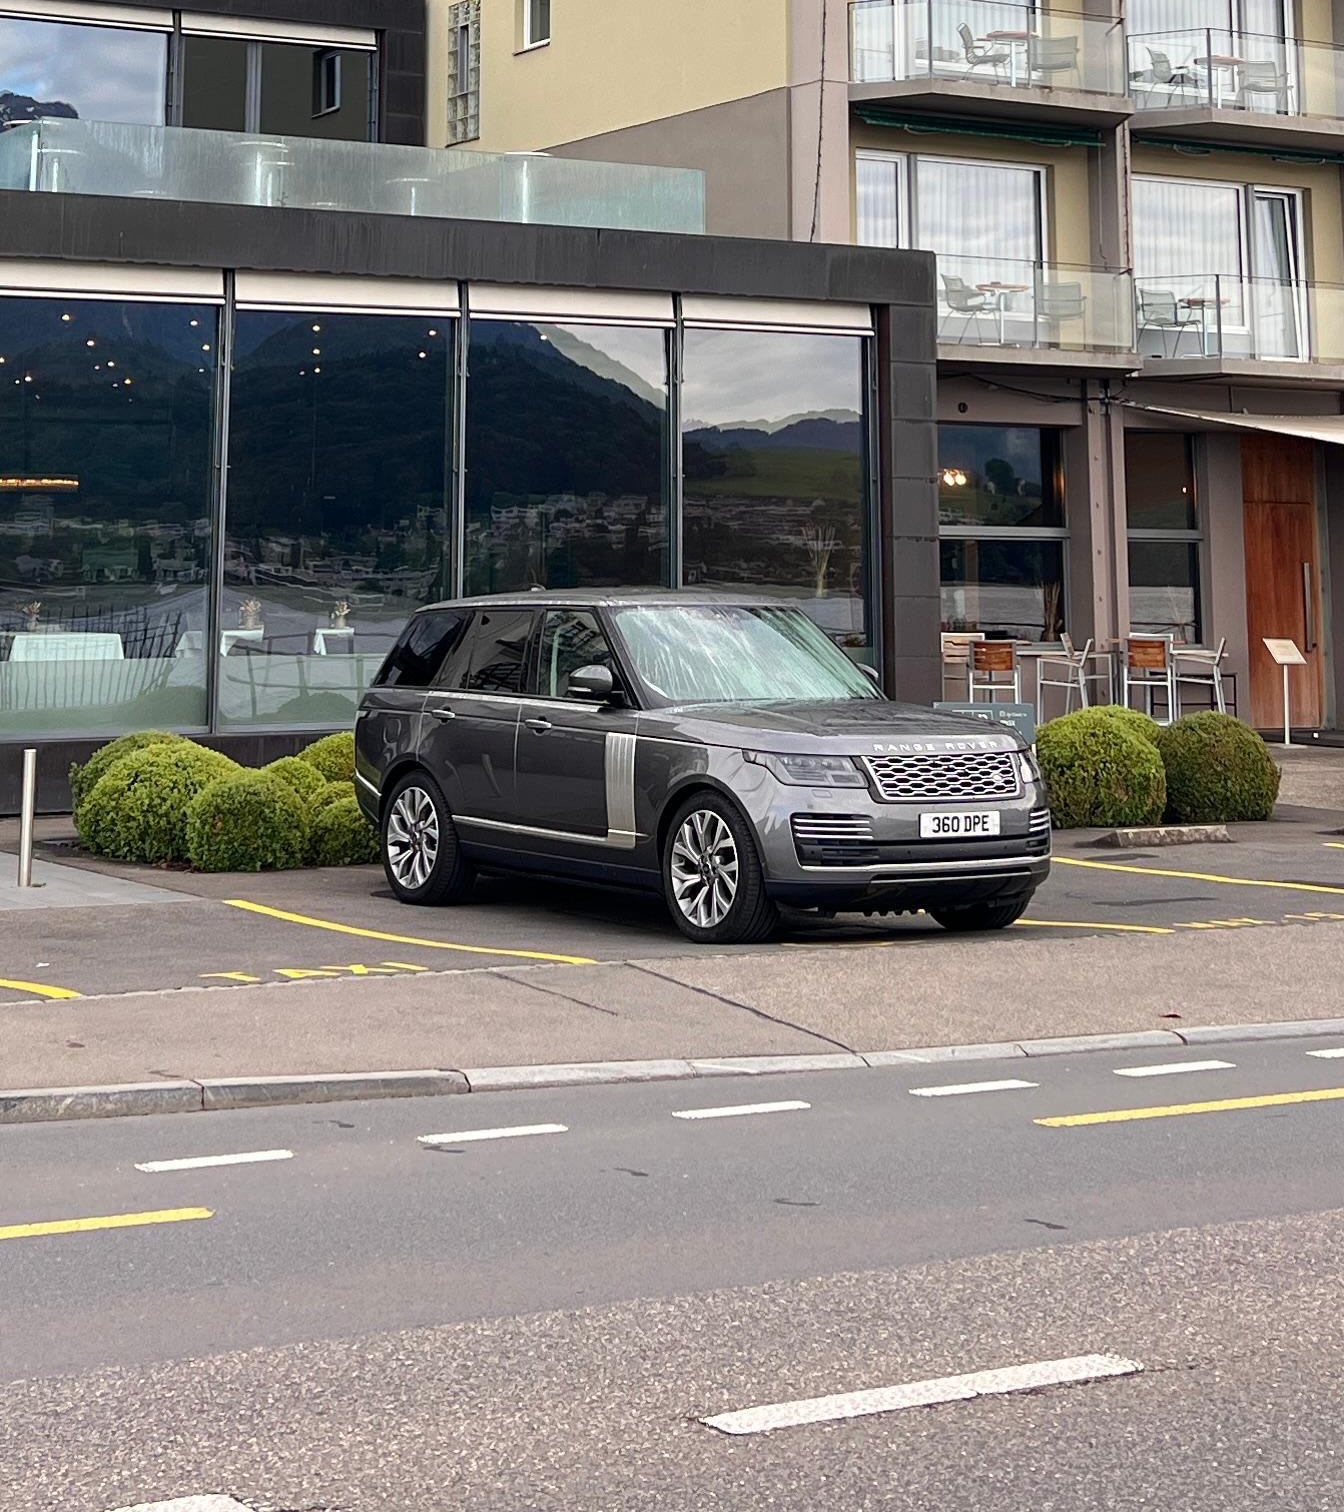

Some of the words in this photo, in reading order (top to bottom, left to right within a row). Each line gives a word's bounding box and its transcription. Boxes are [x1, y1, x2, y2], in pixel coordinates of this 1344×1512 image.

[874, 743, 935, 752] RANGE
[945, 741, 998, 751] ROVER
[932, 817, 960, 834] 360
[963, 815, 990, 833] DPE
[198, 961, 429, 982] TAXI
